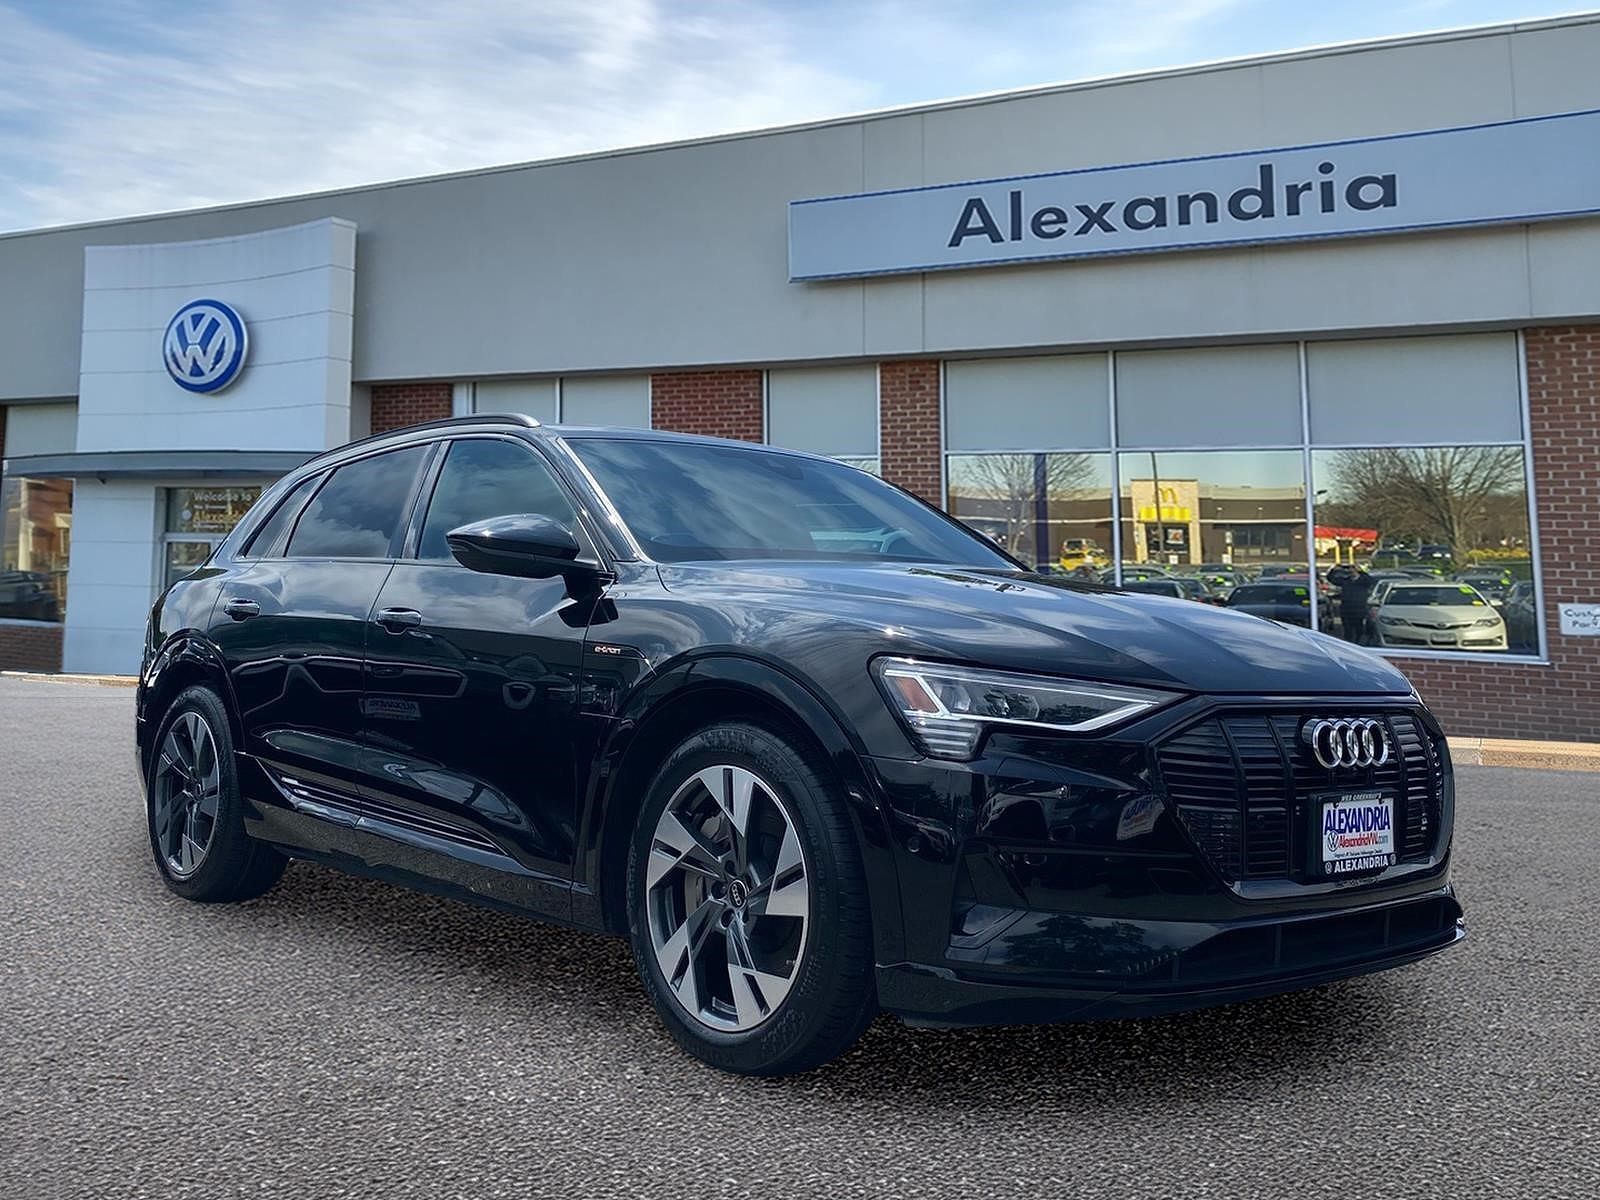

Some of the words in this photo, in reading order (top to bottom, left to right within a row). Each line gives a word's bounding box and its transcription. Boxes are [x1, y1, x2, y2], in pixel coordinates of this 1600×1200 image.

[947, 161, 1398, 248] Alexandria
[164, 305, 237, 386] VW
[1324, 806, 1390, 835] ALEXANDRIA
[1334, 856, 1388, 873] ALEXANDRIA
